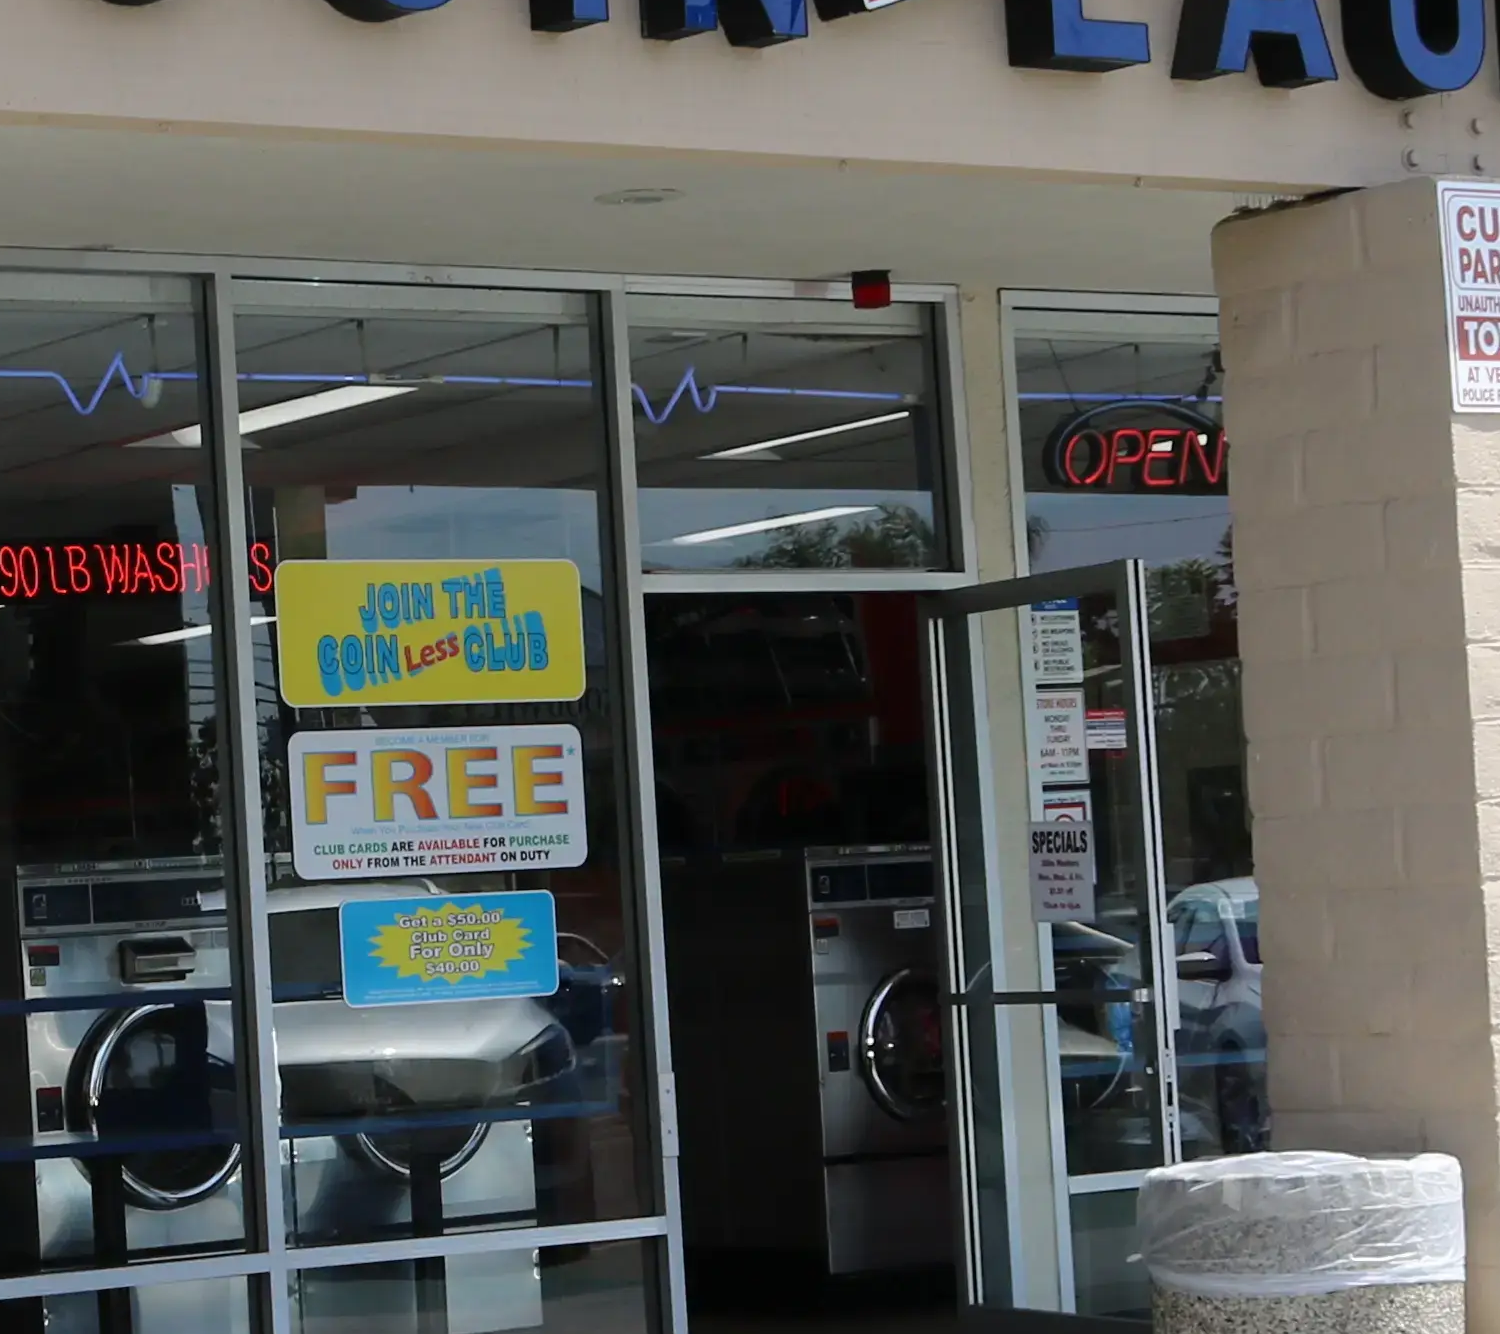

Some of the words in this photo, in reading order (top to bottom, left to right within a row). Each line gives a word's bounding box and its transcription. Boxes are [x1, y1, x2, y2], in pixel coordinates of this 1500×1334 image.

[1467, 366, 1480, 383] AT
[1462, 388, 1494, 402] POLICE
[1064, 428, 1228, 486] OPEN
[44, 545, 91, 596] LB
[94, 542, 273, 594] WASHS
[358, 582, 435, 626] JOIN
[441, 572, 507, 619] THE
[317, 634, 401, 685] COIN
[403, 633, 460, 674] Less
[463, 623, 549, 673] CLUB
[314, 843, 346, 856] CLUB
[348, 842, 388, 855] CARDS
[391, 841, 415, 853] ARE
[417, 838, 480, 851] AVAILABLE
[483, 836, 506, 849] FOR
[509, 834, 570, 847] PURCHASE
[1031, 830, 1087, 854] SPECIALS
[332, 858, 363, 870] ONLY
[366, 857, 400, 869] FROM
[403, 855, 426, 867] THE
[429, 852, 496, 866] ATTENDANT
[500, 851, 517, 863] ON
[520, 849, 551, 862] DUTY
[398, 916, 429, 929] Get
[432, 917, 443, 927] a
[447, 912, 501, 927] $50.00
[411, 930, 448, 944] Club
[452, 928, 491, 942] Card
[409, 945, 441, 960] For
[449, 942, 495, 959] Only
[425, 960, 481, 975] $40.00
